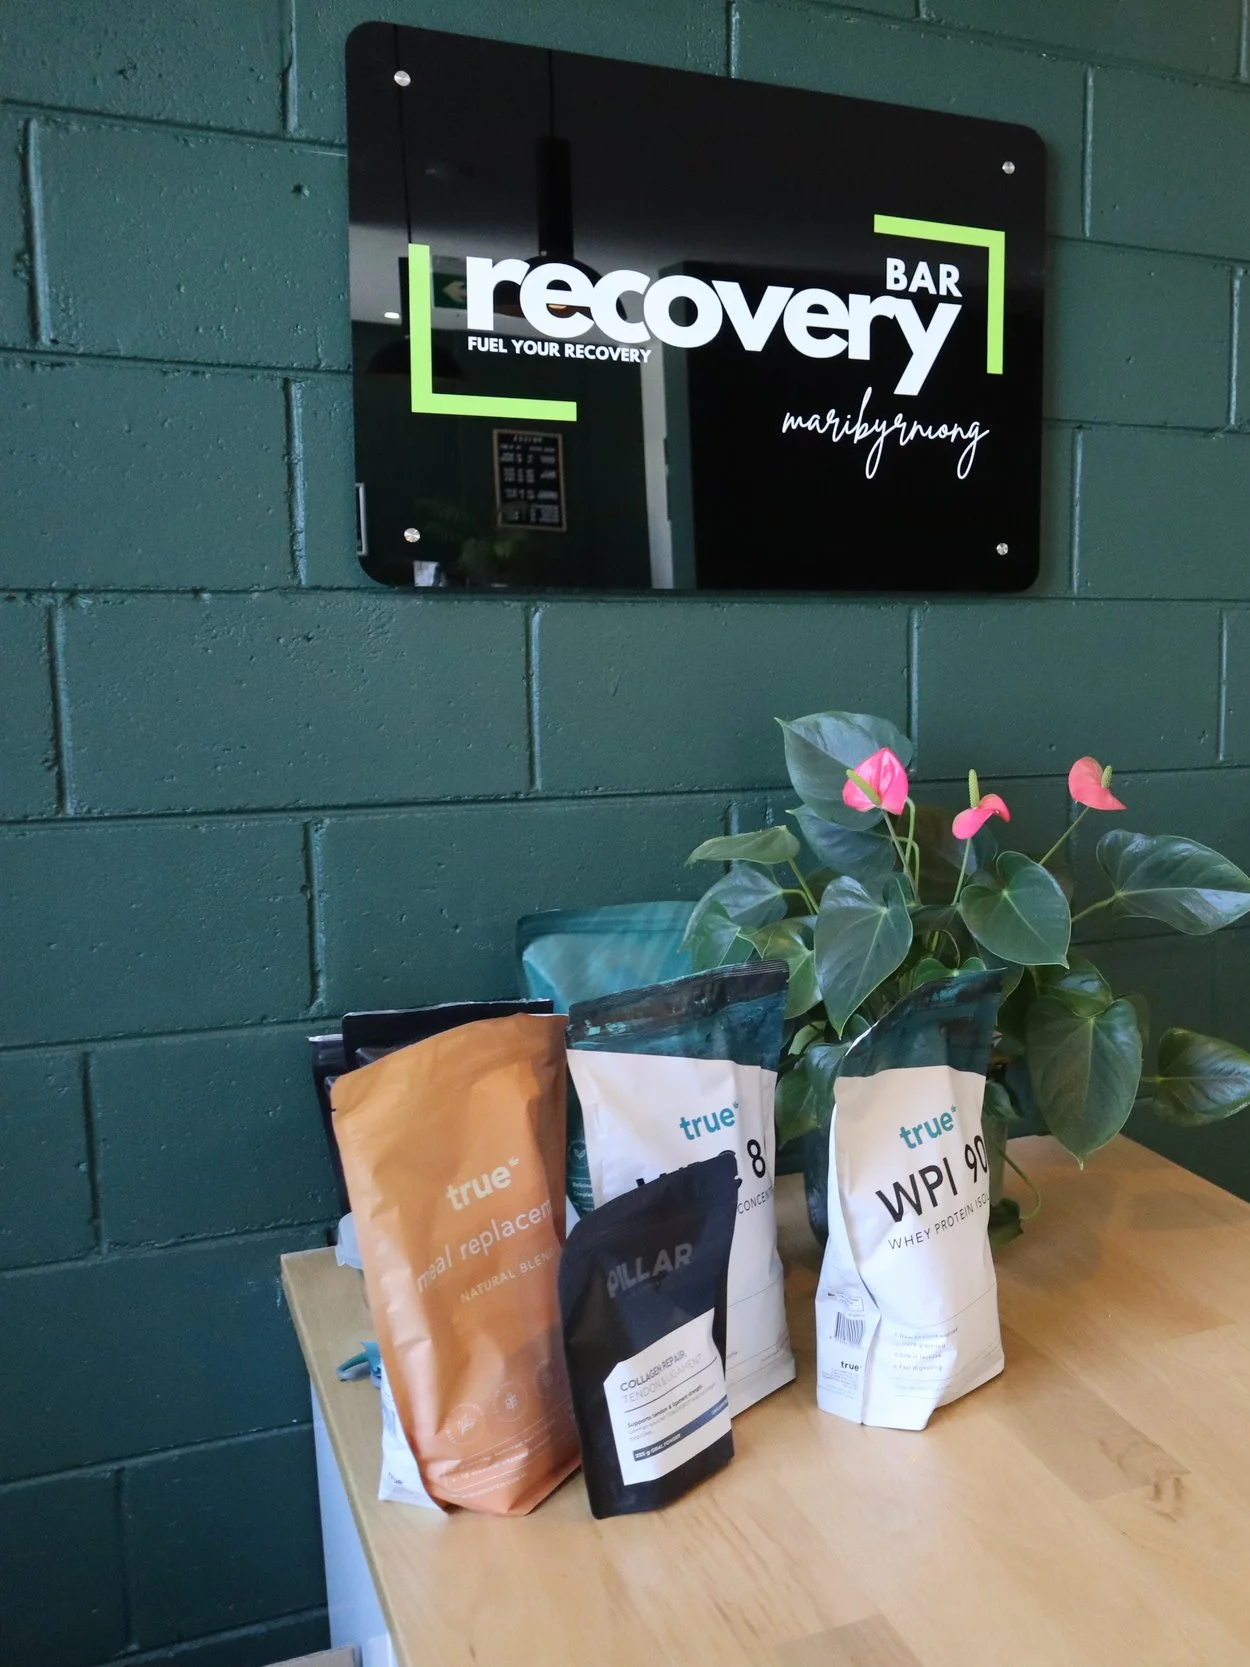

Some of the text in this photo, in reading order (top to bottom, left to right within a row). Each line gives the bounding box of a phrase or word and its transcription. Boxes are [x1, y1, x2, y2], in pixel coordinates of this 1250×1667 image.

[886, 257, 963, 297] BAR
[466, 256, 963, 396] recovery
[468, 336, 652, 364] FUEL YOUR RECOVERY
[680, 1107, 736, 1141] true
[899, 1111, 954, 1149] true
[446, 1165, 512, 1212] true
[875, 1135, 988, 1223] WPI 90
[888, 1227, 931, 1250] WHEY
[934, 1203, 975, 1235] PROTEIN
[416, 1244, 453, 1293] meal
[459, 1269, 517, 1303] NATURAL
[606, 1242, 694, 1299] PILLAR
[620, 1349, 687, 1392] COLLAGEN REPAIR
[840, 1360, 860, 1373] true
